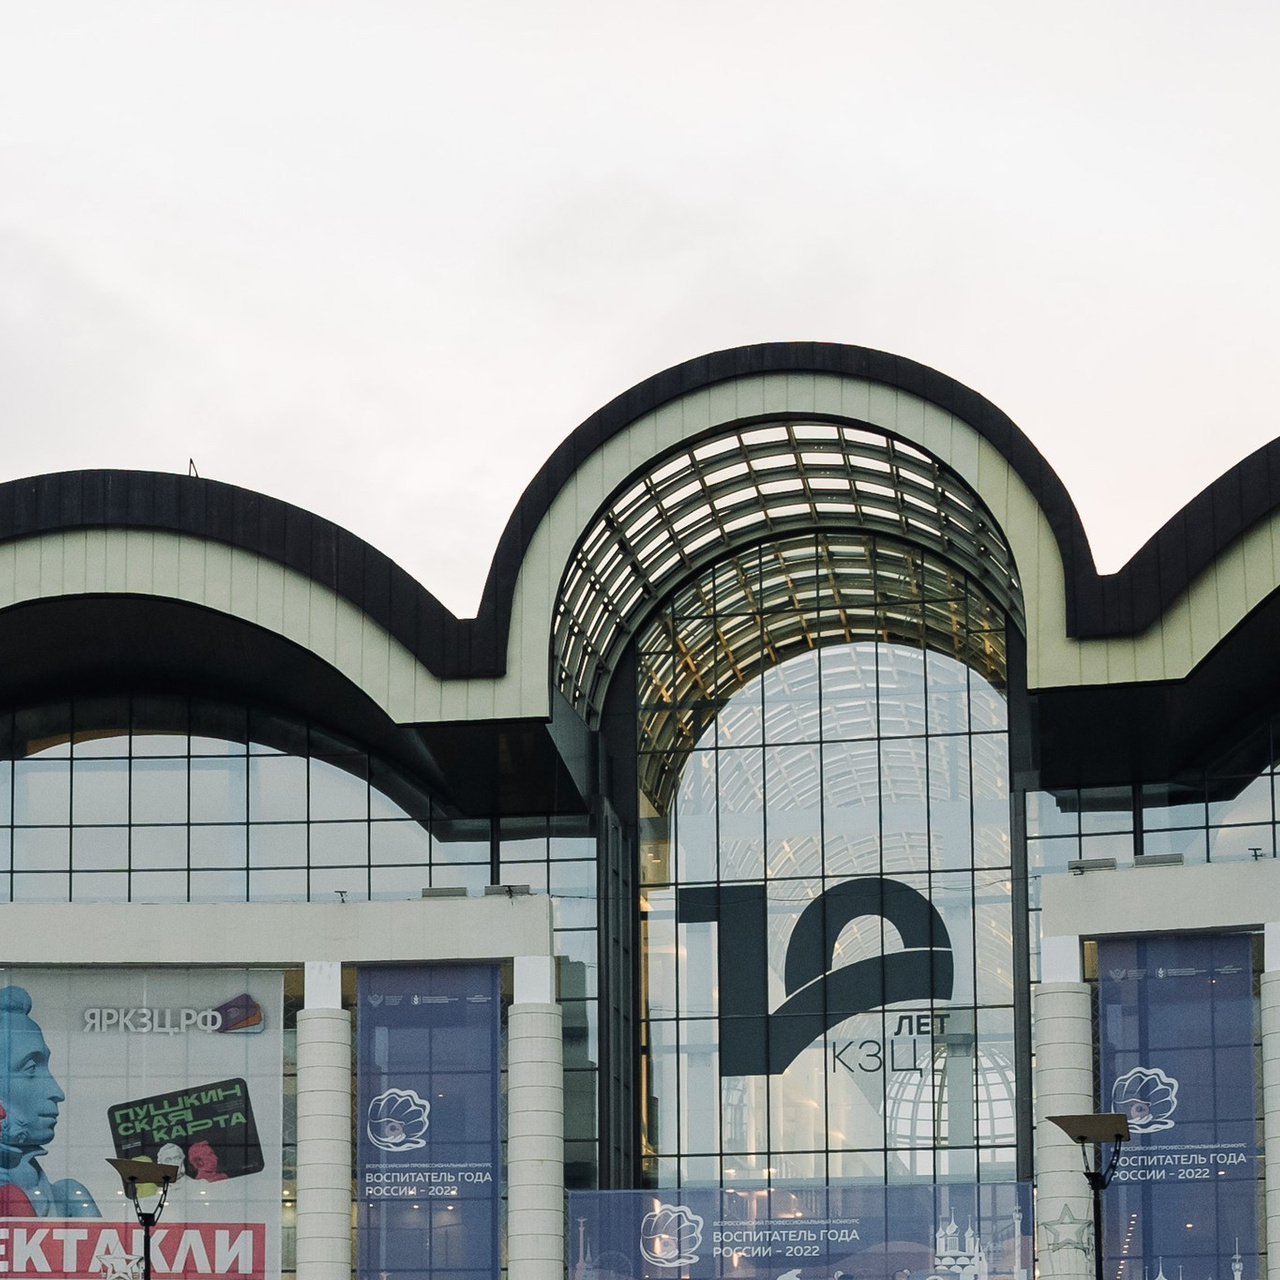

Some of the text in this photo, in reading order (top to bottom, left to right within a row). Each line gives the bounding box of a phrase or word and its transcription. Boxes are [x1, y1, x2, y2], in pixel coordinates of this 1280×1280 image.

[678, 877, 954, 1076] 10
[83, 1008, 223, 1035] ЯРКЗЦ.РФ
[894, 1013, 950, 1036] ЛЕТ
[832, 1038, 923, 1077] КЗЦ
[114, 1084, 242, 1123] ПУШКИН
[118, 1109, 194, 1136] СКАЯ
[152, 1112, 247, 1142] КАРТА
[1209, 1153, 1247, 1165] ГОДА
[365, 1172, 493, 1184] ВОСПИТАТЕЛЬ ГОДА
[1178, 1168, 1210, 1179] 2022
[365, 1186, 417, 1196] РОССИИ
[428, 1186, 458, 1196] 2022
[713, 1229, 860, 1243] ВОСПИТАТЕЛЬ ГОДА
[713, 1246, 772, 1258] РОССИИ
[785, 1246, 820, 1257] 2022
